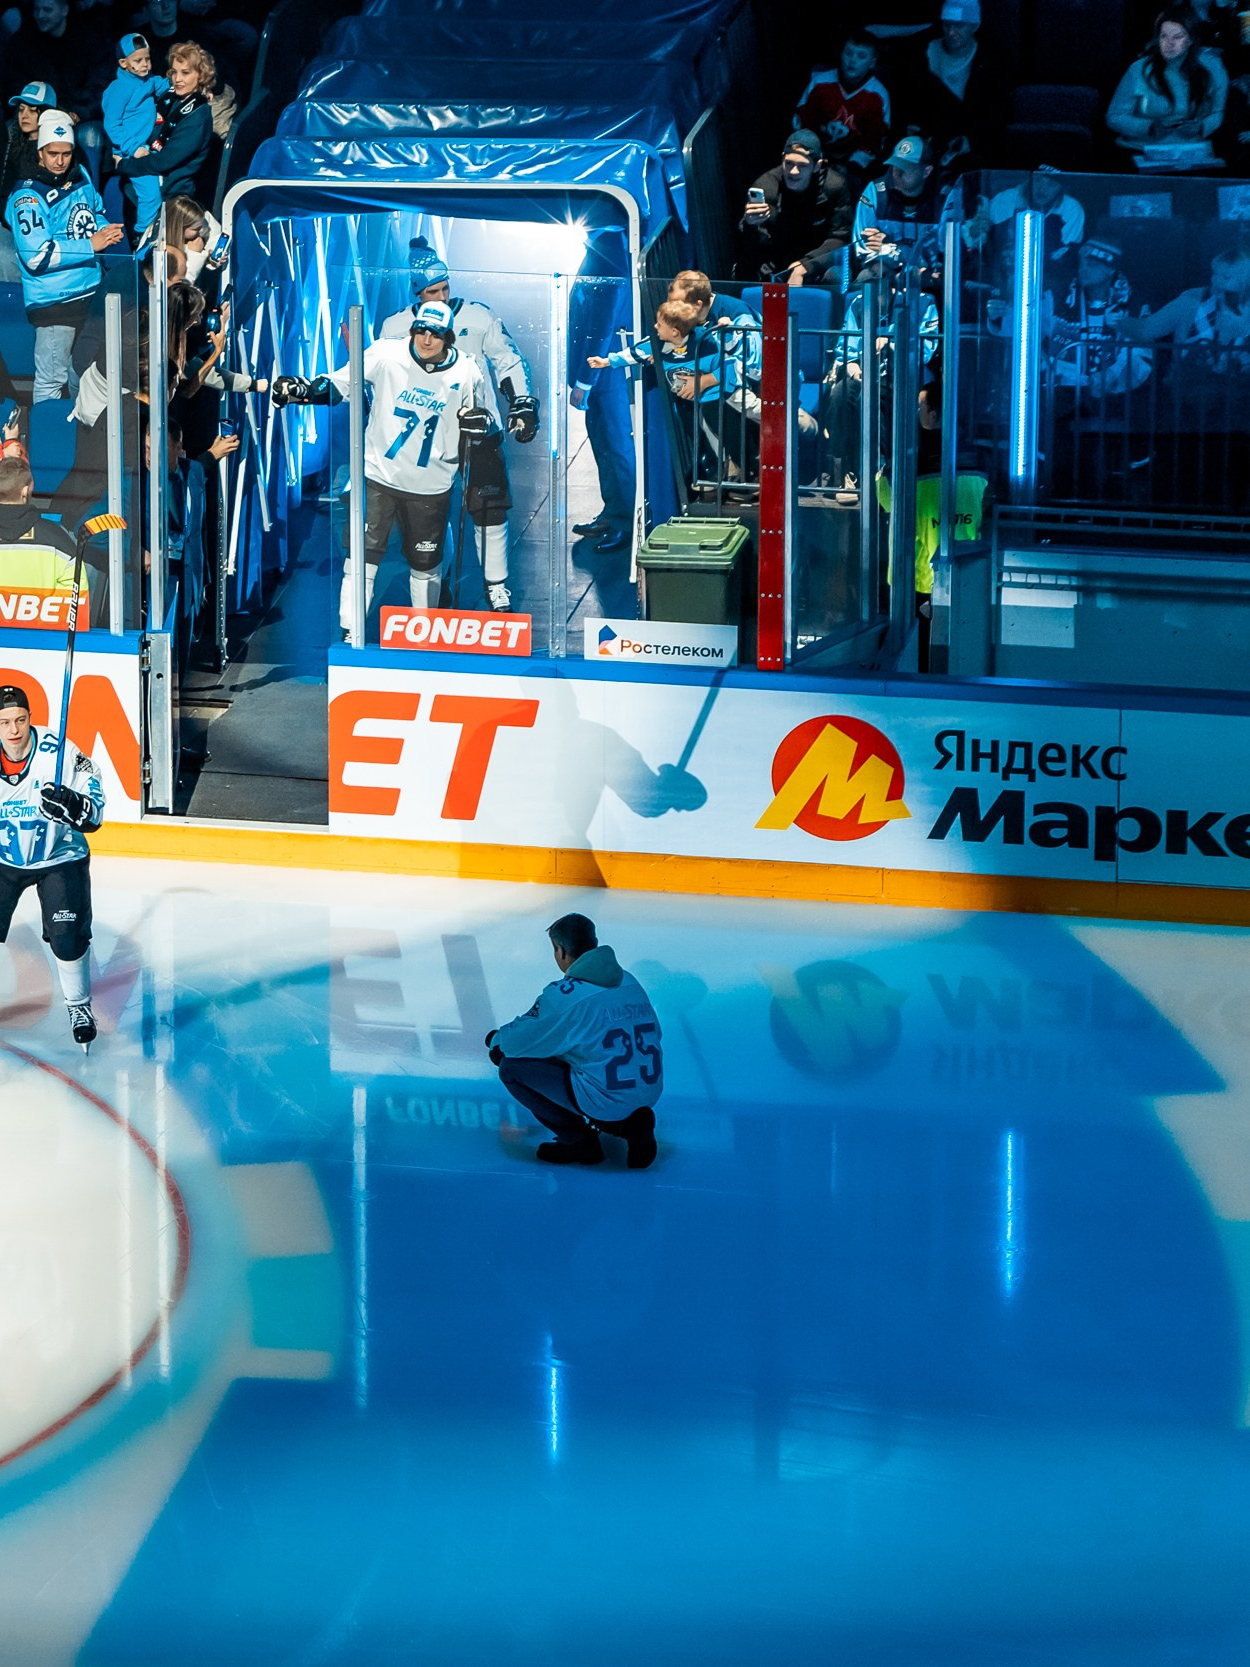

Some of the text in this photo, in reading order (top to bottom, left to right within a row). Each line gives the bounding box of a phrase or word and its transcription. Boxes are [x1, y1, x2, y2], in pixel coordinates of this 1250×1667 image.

[17, 208, 46, 236] 54
[413, 386, 436, 396] FONBET
[384, 406, 441, 468] 71
[383, 615, 528, 649] FONBET
[620, 638, 724, 658] Ростелеком
[933, 730, 1128, 783] Яндекс
[602, 1022, 662, 1090] 25
